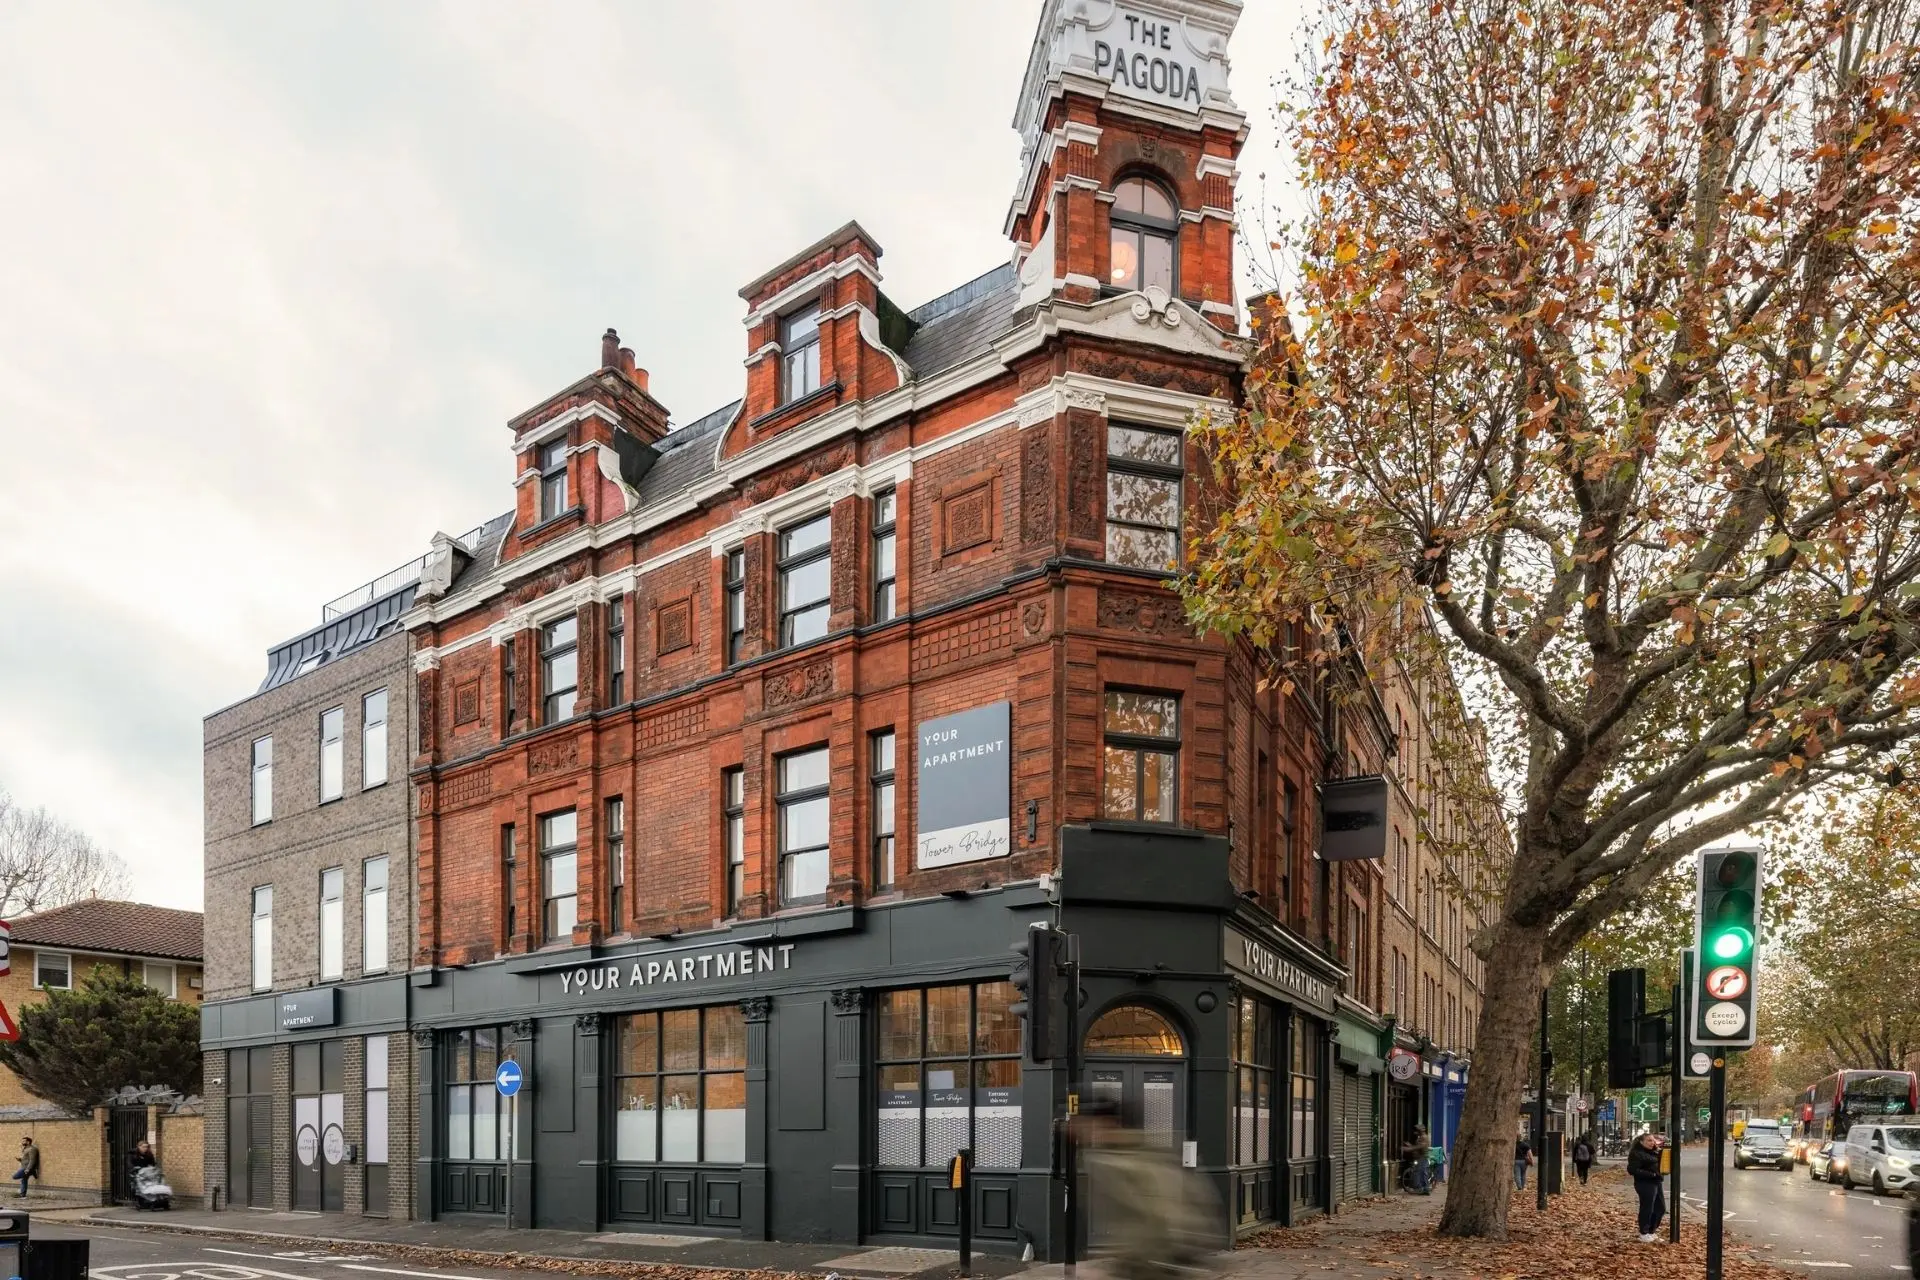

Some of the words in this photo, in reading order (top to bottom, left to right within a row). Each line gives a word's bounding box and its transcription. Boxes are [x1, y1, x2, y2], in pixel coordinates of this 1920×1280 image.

[1125, 14, 1171, 51] THE
[1094, 40, 1201, 105] PAGODA
[924, 729, 958, 746] YOUR
[924, 740, 1004, 769] APARTMENT
[920, 837, 954, 858] Tower
[959, 830, 1007, 857] Bridge
[560, 967, 621, 996] YOUR
[629, 943, 795, 987] APARTMENT
[1244, 939, 1275, 979] YOUR
[1276, 958, 1327, 1005] APARTMENT
